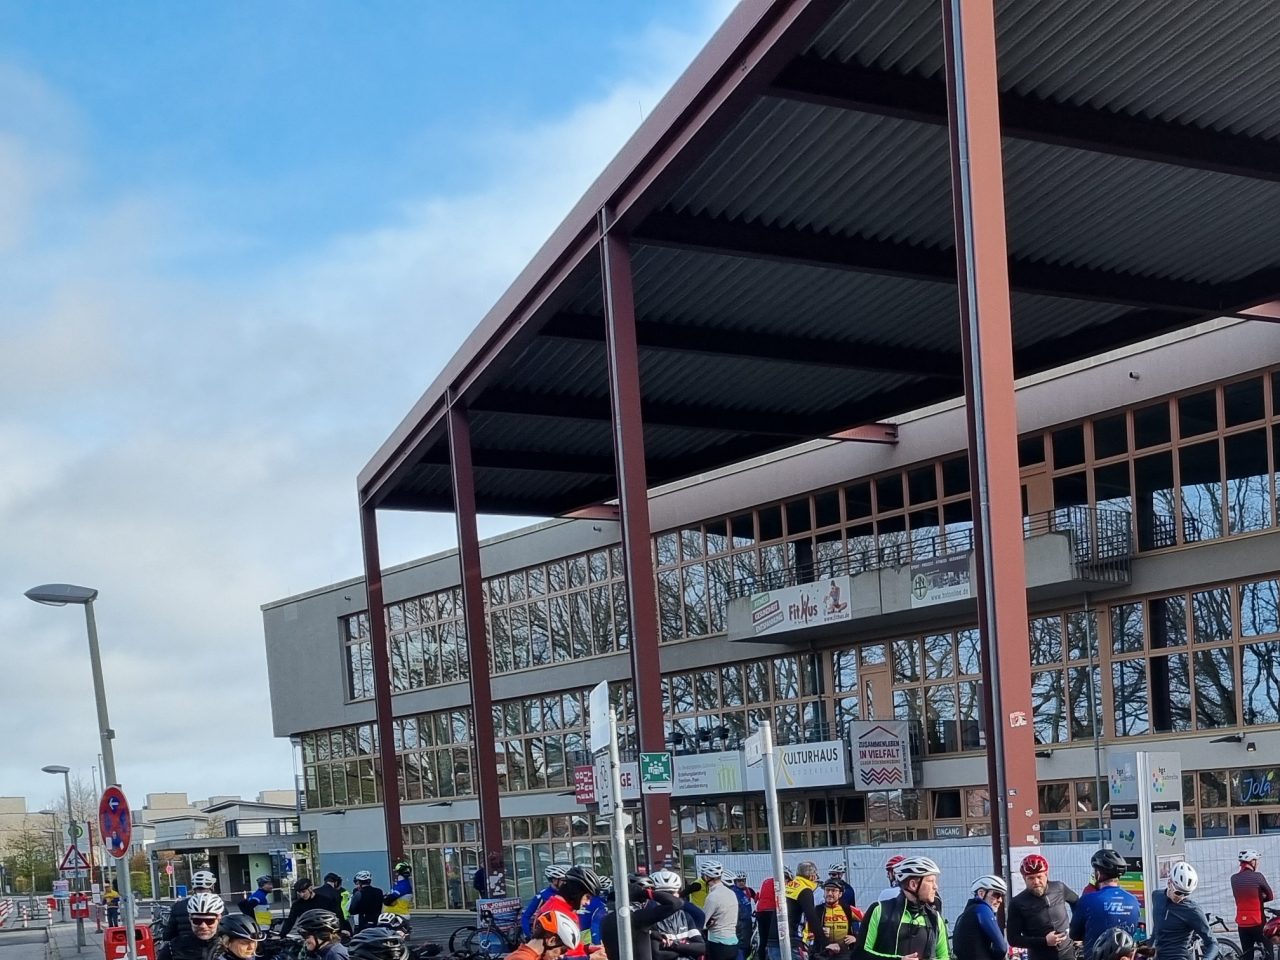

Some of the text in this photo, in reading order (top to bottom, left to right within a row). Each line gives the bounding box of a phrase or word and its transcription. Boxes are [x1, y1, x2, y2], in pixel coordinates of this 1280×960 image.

[782, 748, 838, 766] KULTURHAUS
[860, 749, 900, 759] IN VIELFALT
[936, 827, 960, 836] EINGANG
